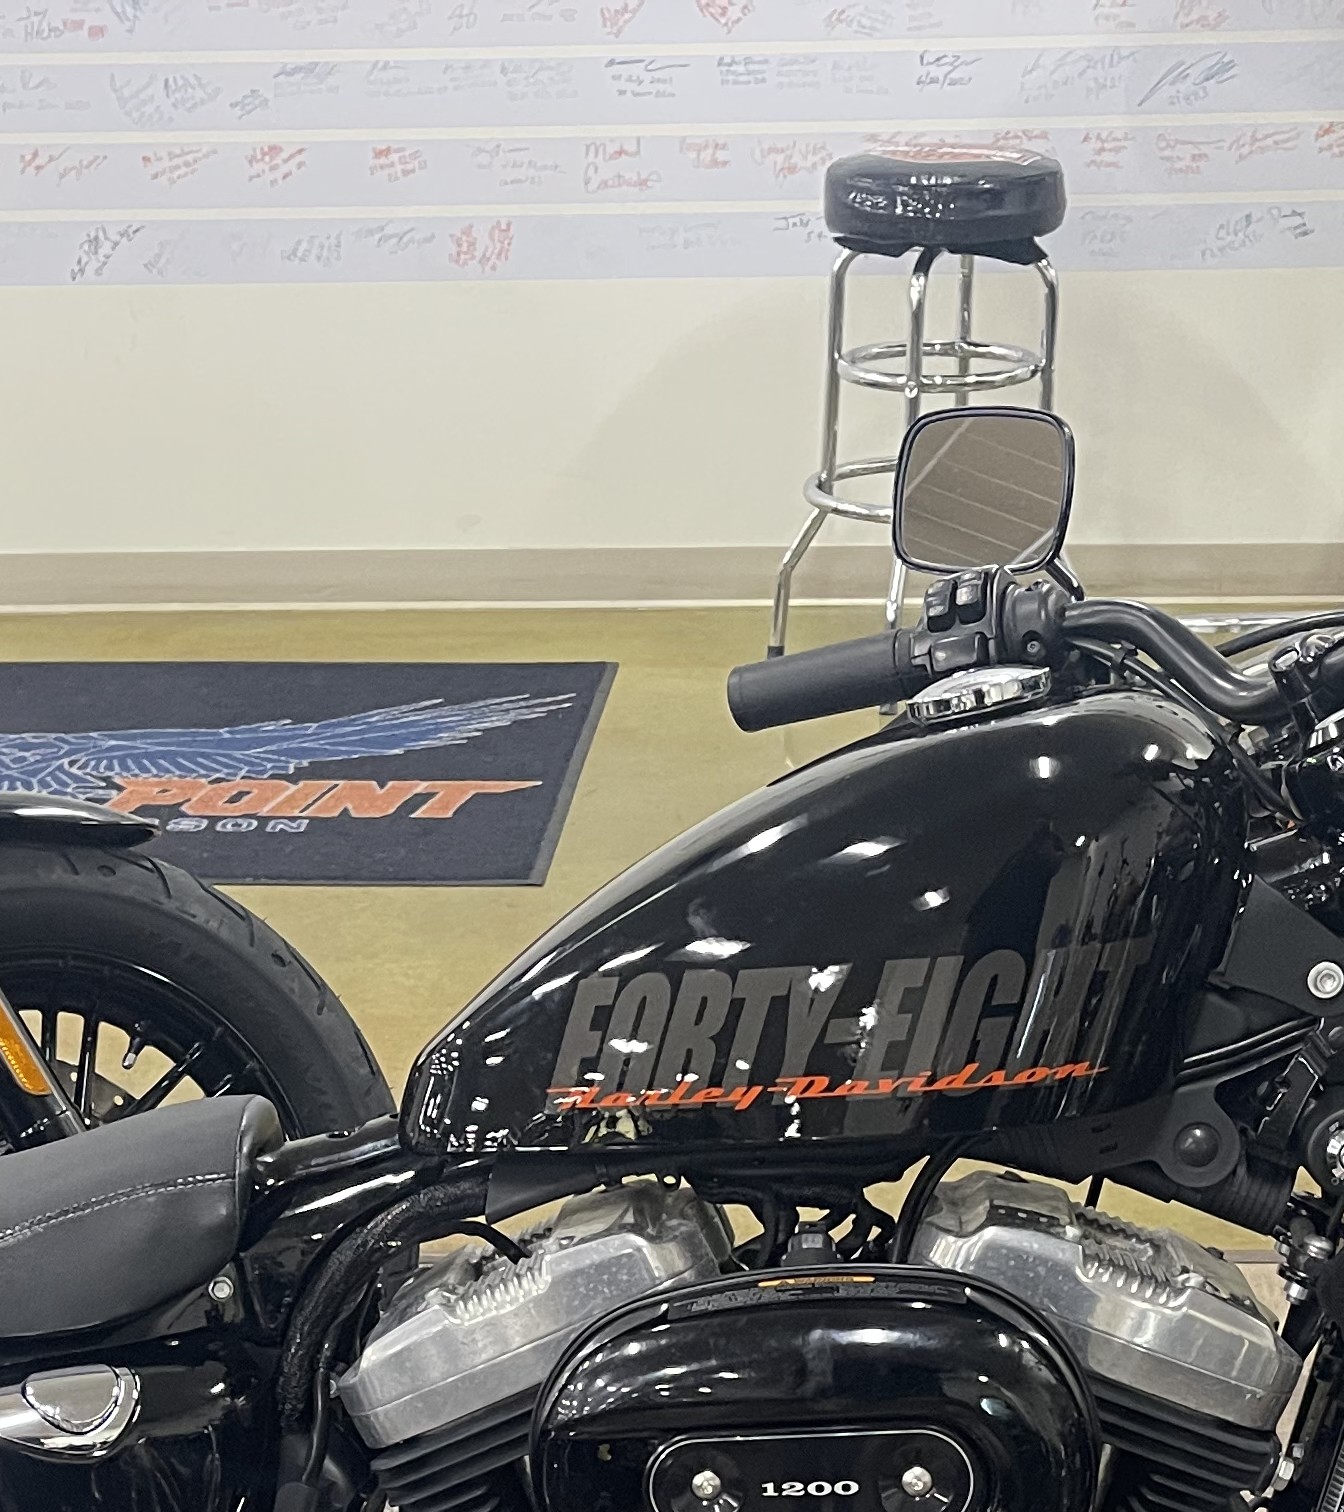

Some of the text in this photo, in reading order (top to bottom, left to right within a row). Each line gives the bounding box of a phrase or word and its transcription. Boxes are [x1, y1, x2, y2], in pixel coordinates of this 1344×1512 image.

[105, 778, 544, 819] POINT
[547, 935, 1156, 1131] FORTY-EIGHT
[545, 1060, 1109, 1113] Harley-Davidson
[760, 1479, 861, 1498] 1200
